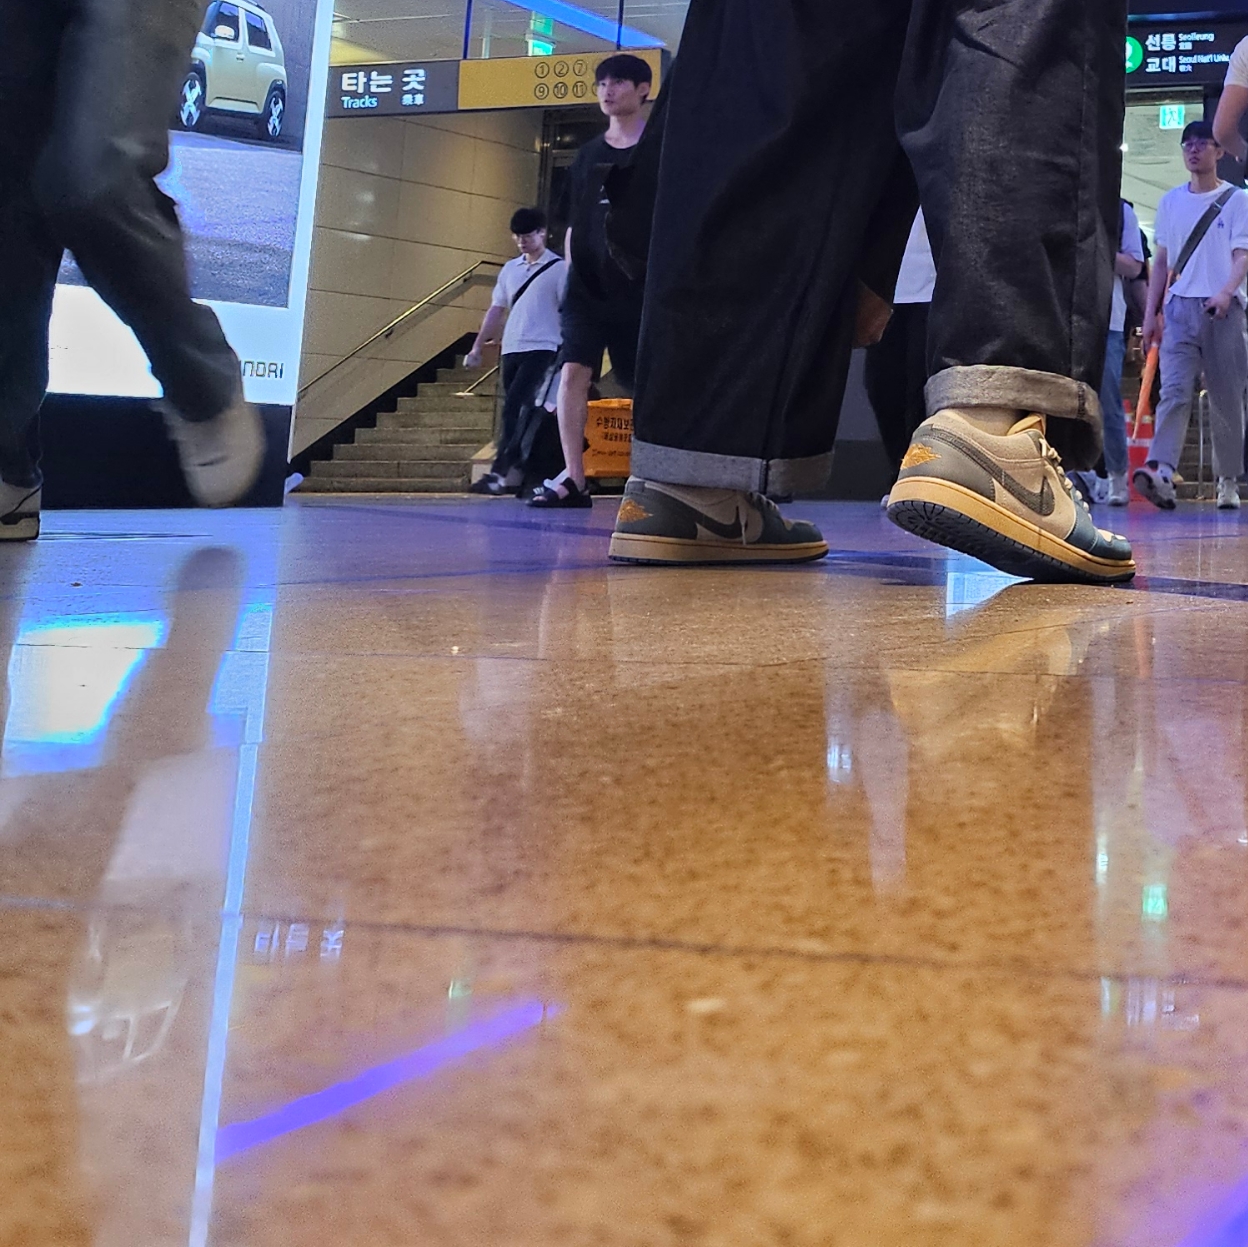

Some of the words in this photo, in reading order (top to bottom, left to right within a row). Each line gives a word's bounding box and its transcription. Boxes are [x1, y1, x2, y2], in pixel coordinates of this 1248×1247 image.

[1145, 33, 1176, 51] 선릉
[1145, 56, 1177, 73] 교대
[341, 70, 393, 94] 타는
[402, 69, 426, 92] 곳
[341, 94, 378, 109] Tracks
